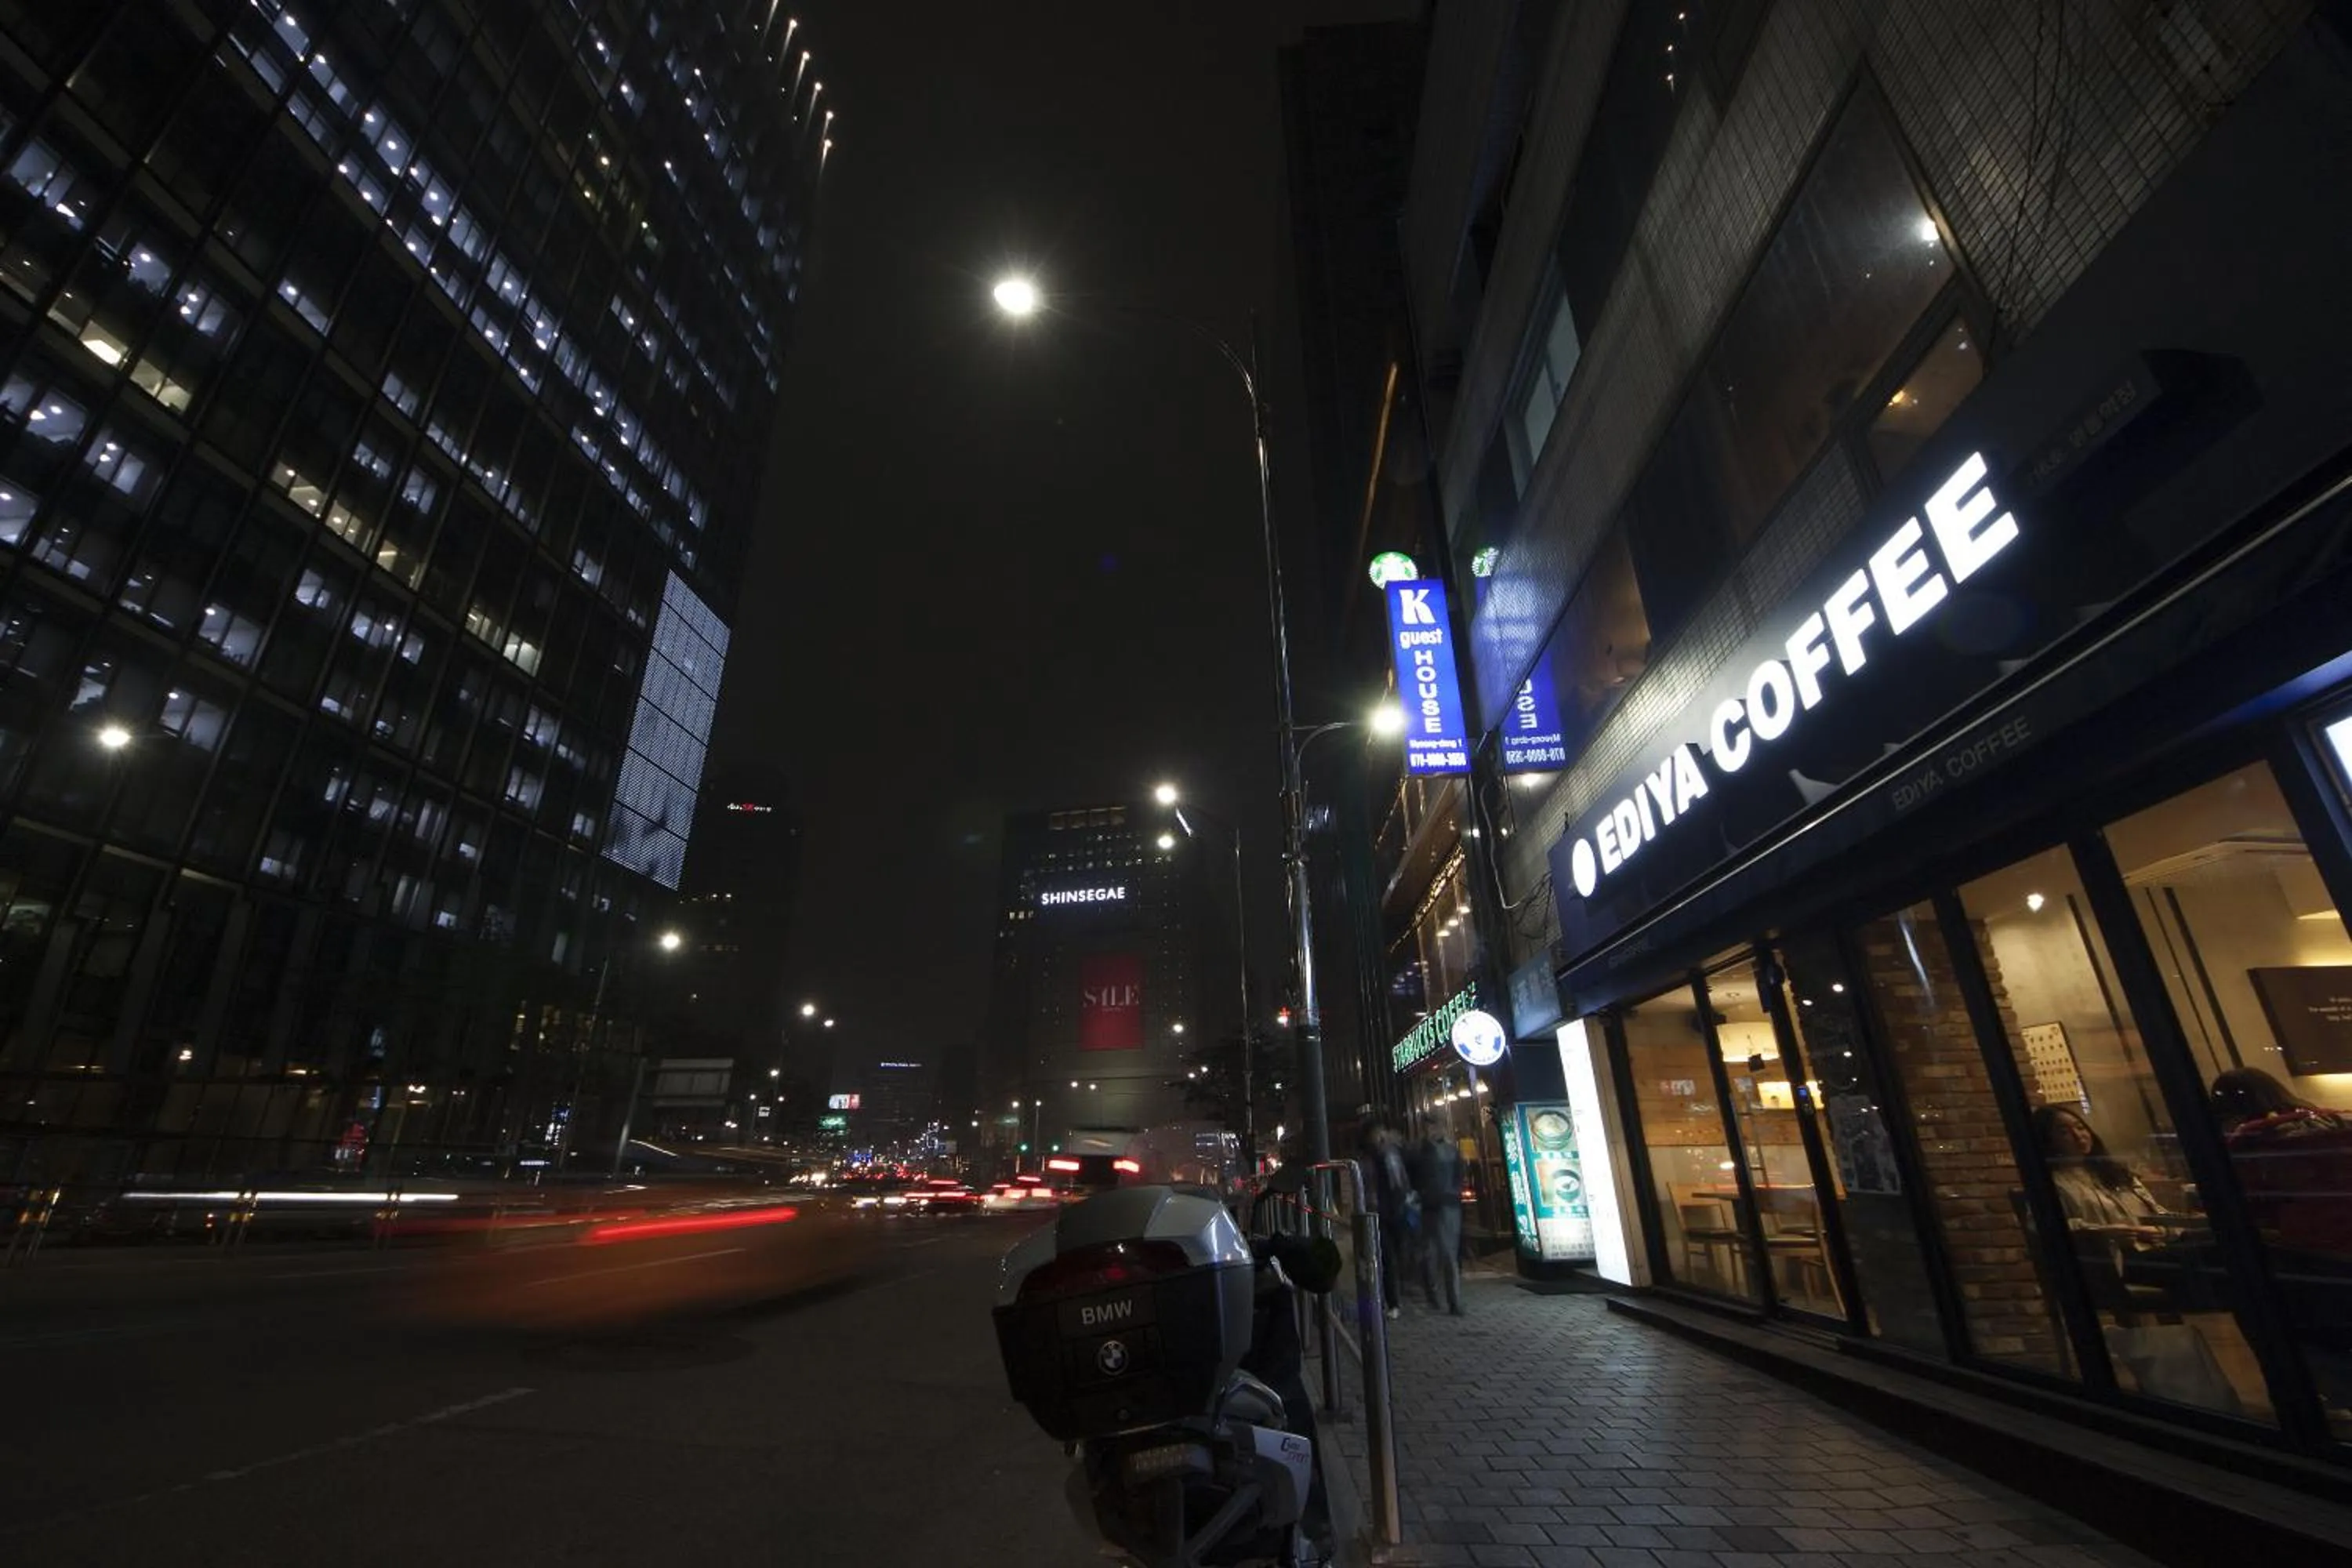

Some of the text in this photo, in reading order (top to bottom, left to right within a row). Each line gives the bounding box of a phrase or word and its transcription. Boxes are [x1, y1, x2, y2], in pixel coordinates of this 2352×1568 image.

[1399, 589, 1436, 625] K
[1399, 628, 1443, 650] guest
[1596, 452, 2020, 875] EDIYA COFFEE
[1414, 650, 1442, 733] HOUSE
[1892, 714, 2032, 811] EDIYA COFFEE
[1041, 887, 1125, 906] SHINSEGAE
[1081, 1298, 1132, 1325] BMW
